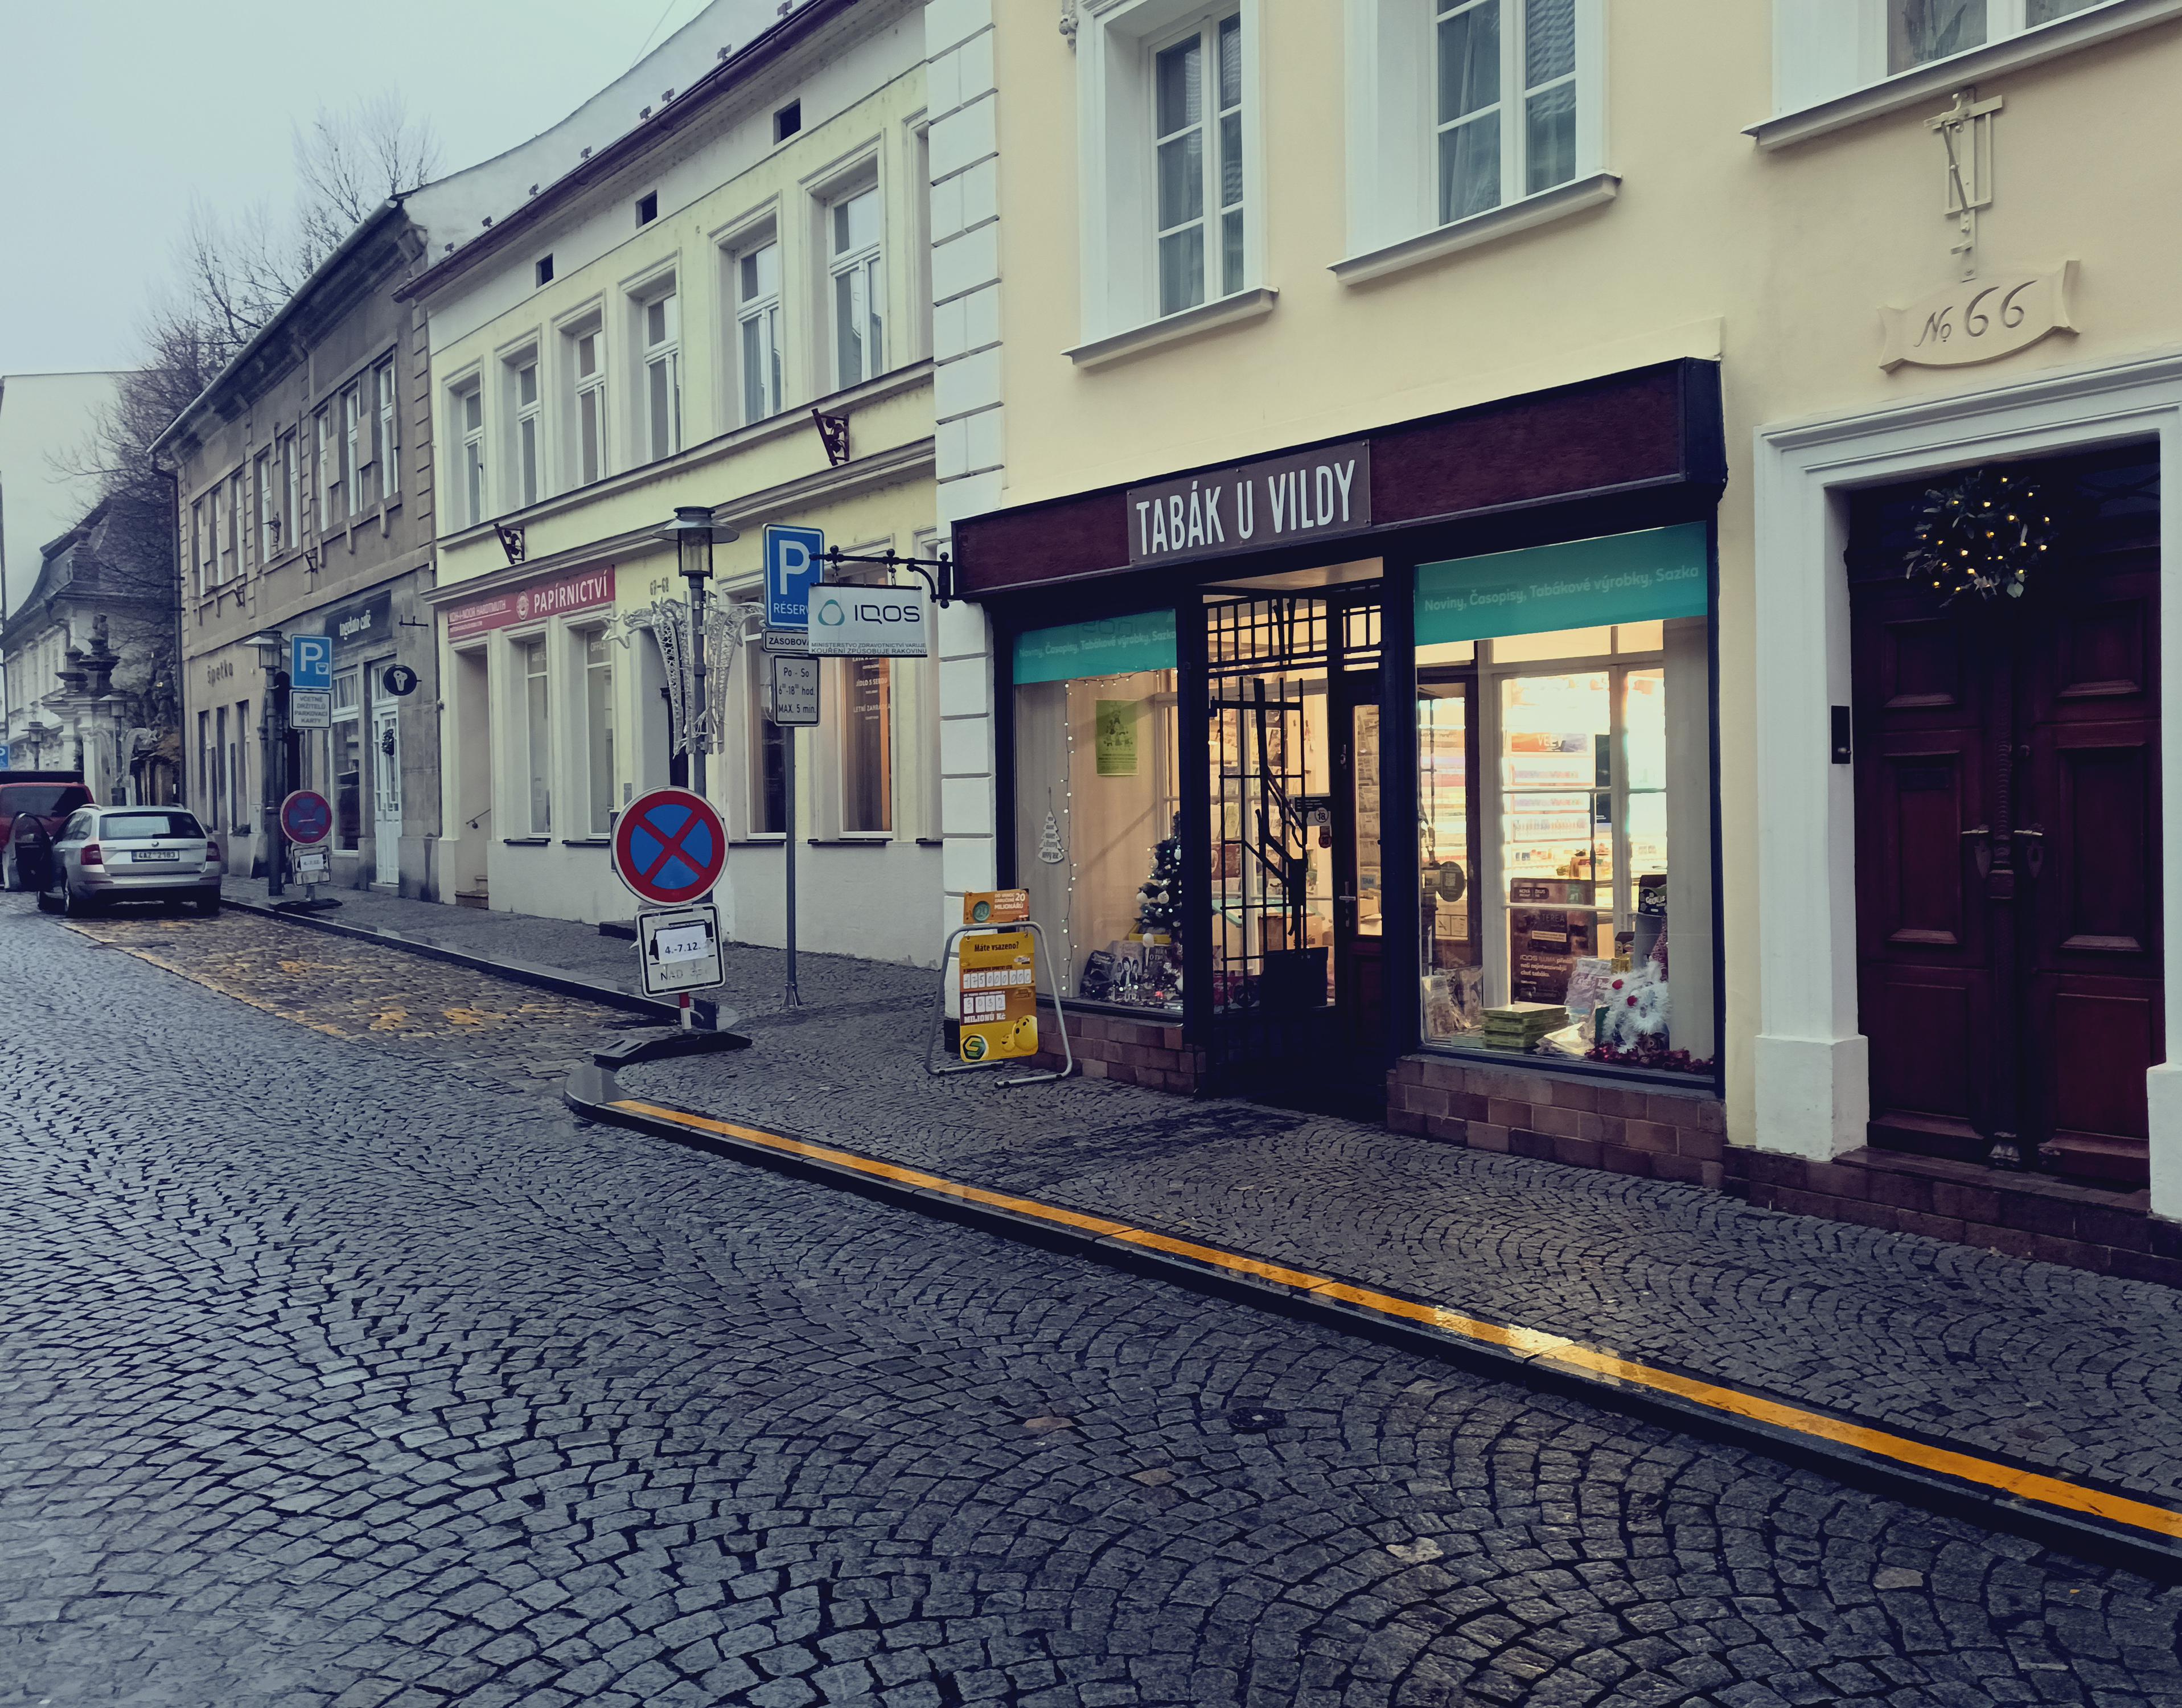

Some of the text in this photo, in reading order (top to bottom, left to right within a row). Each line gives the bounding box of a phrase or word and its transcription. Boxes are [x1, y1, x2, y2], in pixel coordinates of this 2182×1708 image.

[1965, 280, 2038, 337] 66
[1136, 459, 1355, 556] TABÁK U VILDY
[779, 539, 811, 595] P
[534, 569, 607, 613] PAPÍRNICTVÍ
[1424, 564, 1699, 612] Noviny, Časopisy, Tabákové výrobky, Sazka
[854, 604, 921, 625] IQOS
[300, 642, 323, 672] P
[784, 667, 792, 676] Po
[801, 668, 809, 677] So
[802, 687, 815, 696] hod.
[778, 704, 794, 713] MAX.
[796, 704, 800, 713] 5
[1317, 812, 1326, 820] 18
[1015, 893, 1025, 901] 20
[975, 941, 1019, 952] Máte vsazeno?
